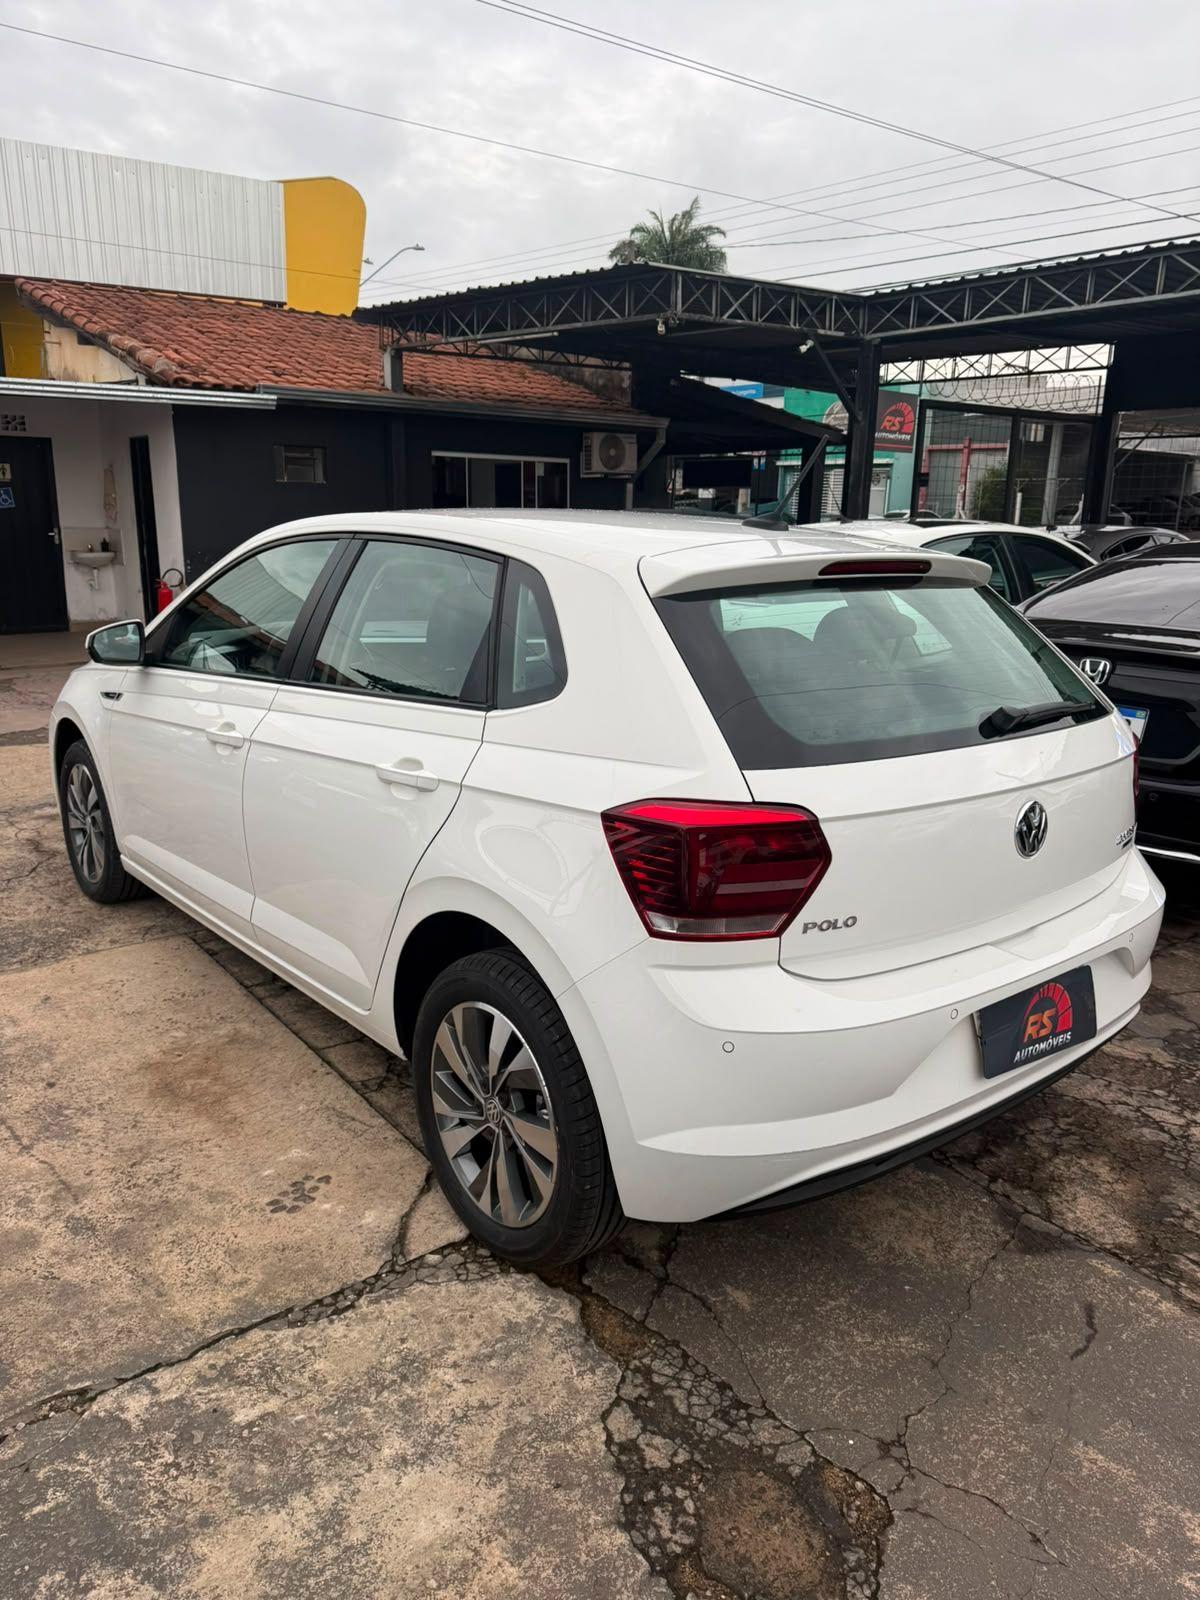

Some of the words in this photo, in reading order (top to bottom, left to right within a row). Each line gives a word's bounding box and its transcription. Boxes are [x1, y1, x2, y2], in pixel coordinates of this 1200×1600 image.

[881, 415, 904, 431] RS
[802, 915, 857, 934] POLO
[1024, 1007, 1057, 1043] RS
[1013, 1031, 1072, 1063] AUTOMÓVEIS
